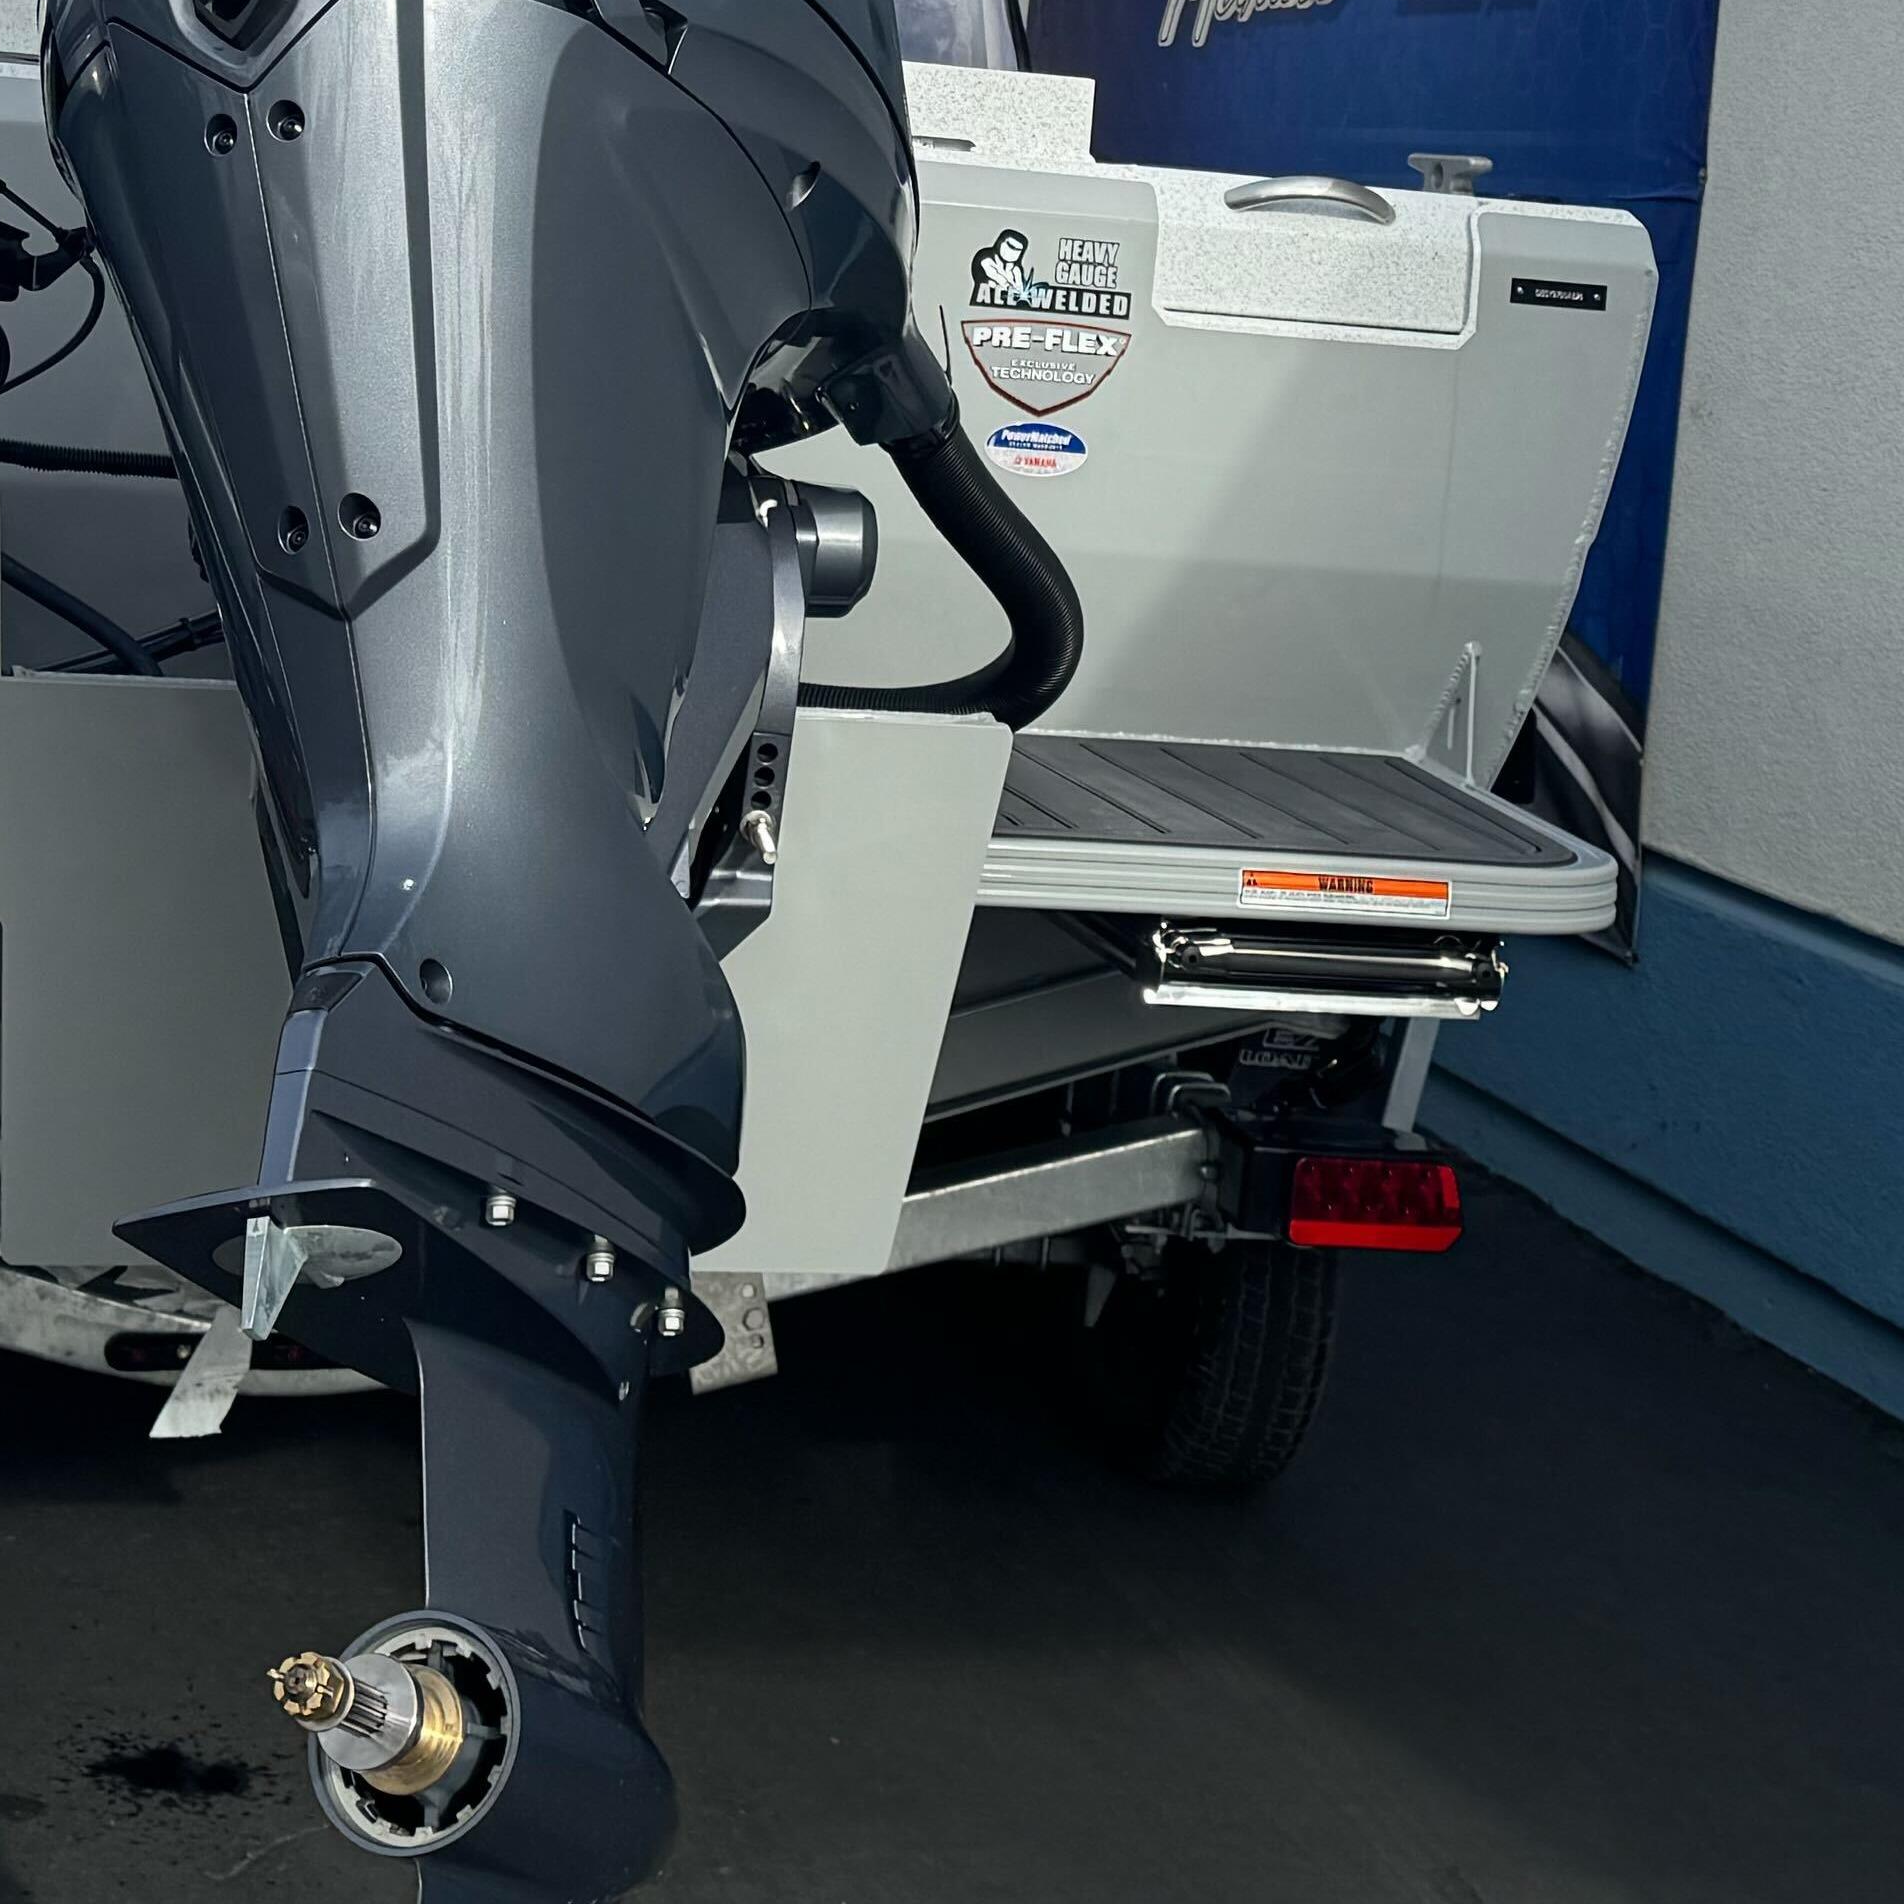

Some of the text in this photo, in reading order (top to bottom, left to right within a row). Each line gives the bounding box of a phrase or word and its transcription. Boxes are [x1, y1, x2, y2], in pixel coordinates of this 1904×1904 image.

[1058, 238, 1120, 266] HEAVY
[1055, 261, 1118, 288] GAUGE
[1029, 286, 1129, 316] WELDED
[992, 366, 1095, 385] TECHNOLOGY
[1011, 358, 1077, 371] EXCLUSIVE
[1317, 876, 1374, 894] WARNING
